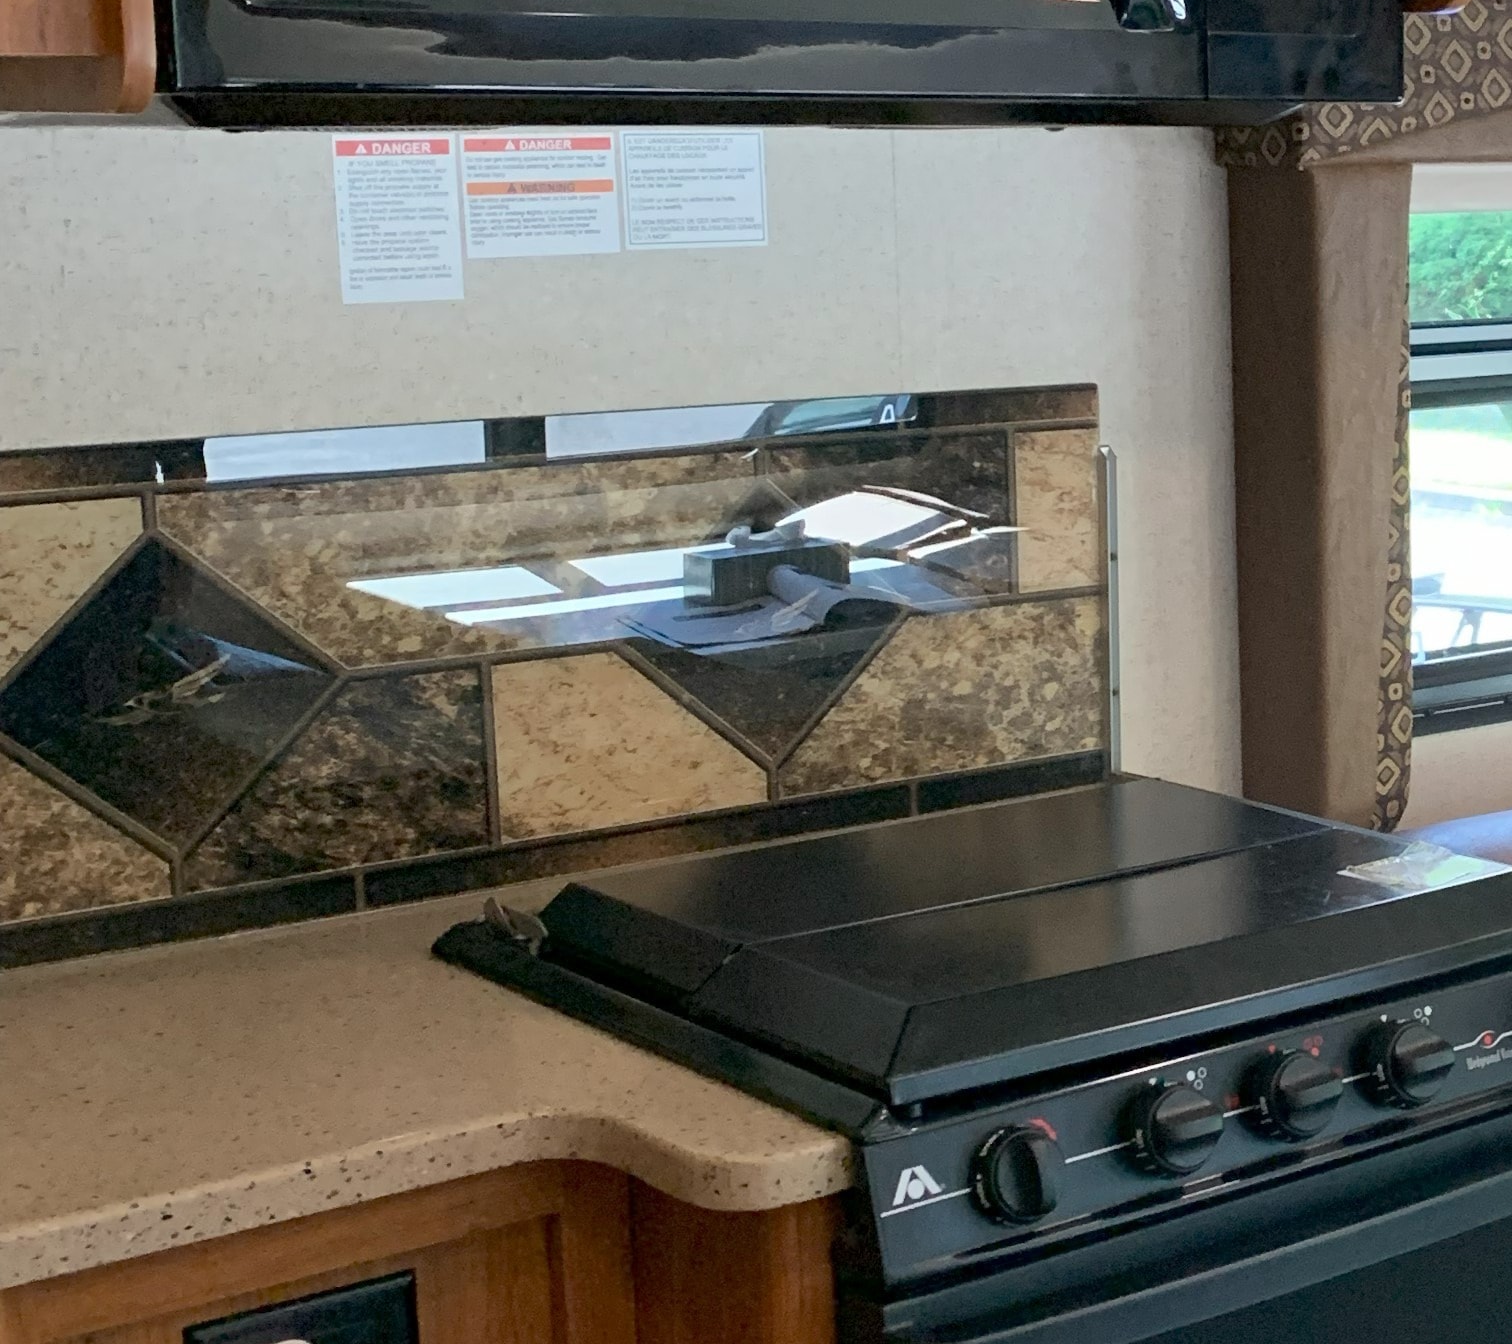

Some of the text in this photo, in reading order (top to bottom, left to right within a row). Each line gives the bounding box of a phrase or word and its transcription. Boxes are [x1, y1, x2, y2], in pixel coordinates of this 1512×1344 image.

[371, 142, 432, 155] DANGER
[519, 139, 573, 151] DANGER
[520, 181, 576, 194] WARNING
